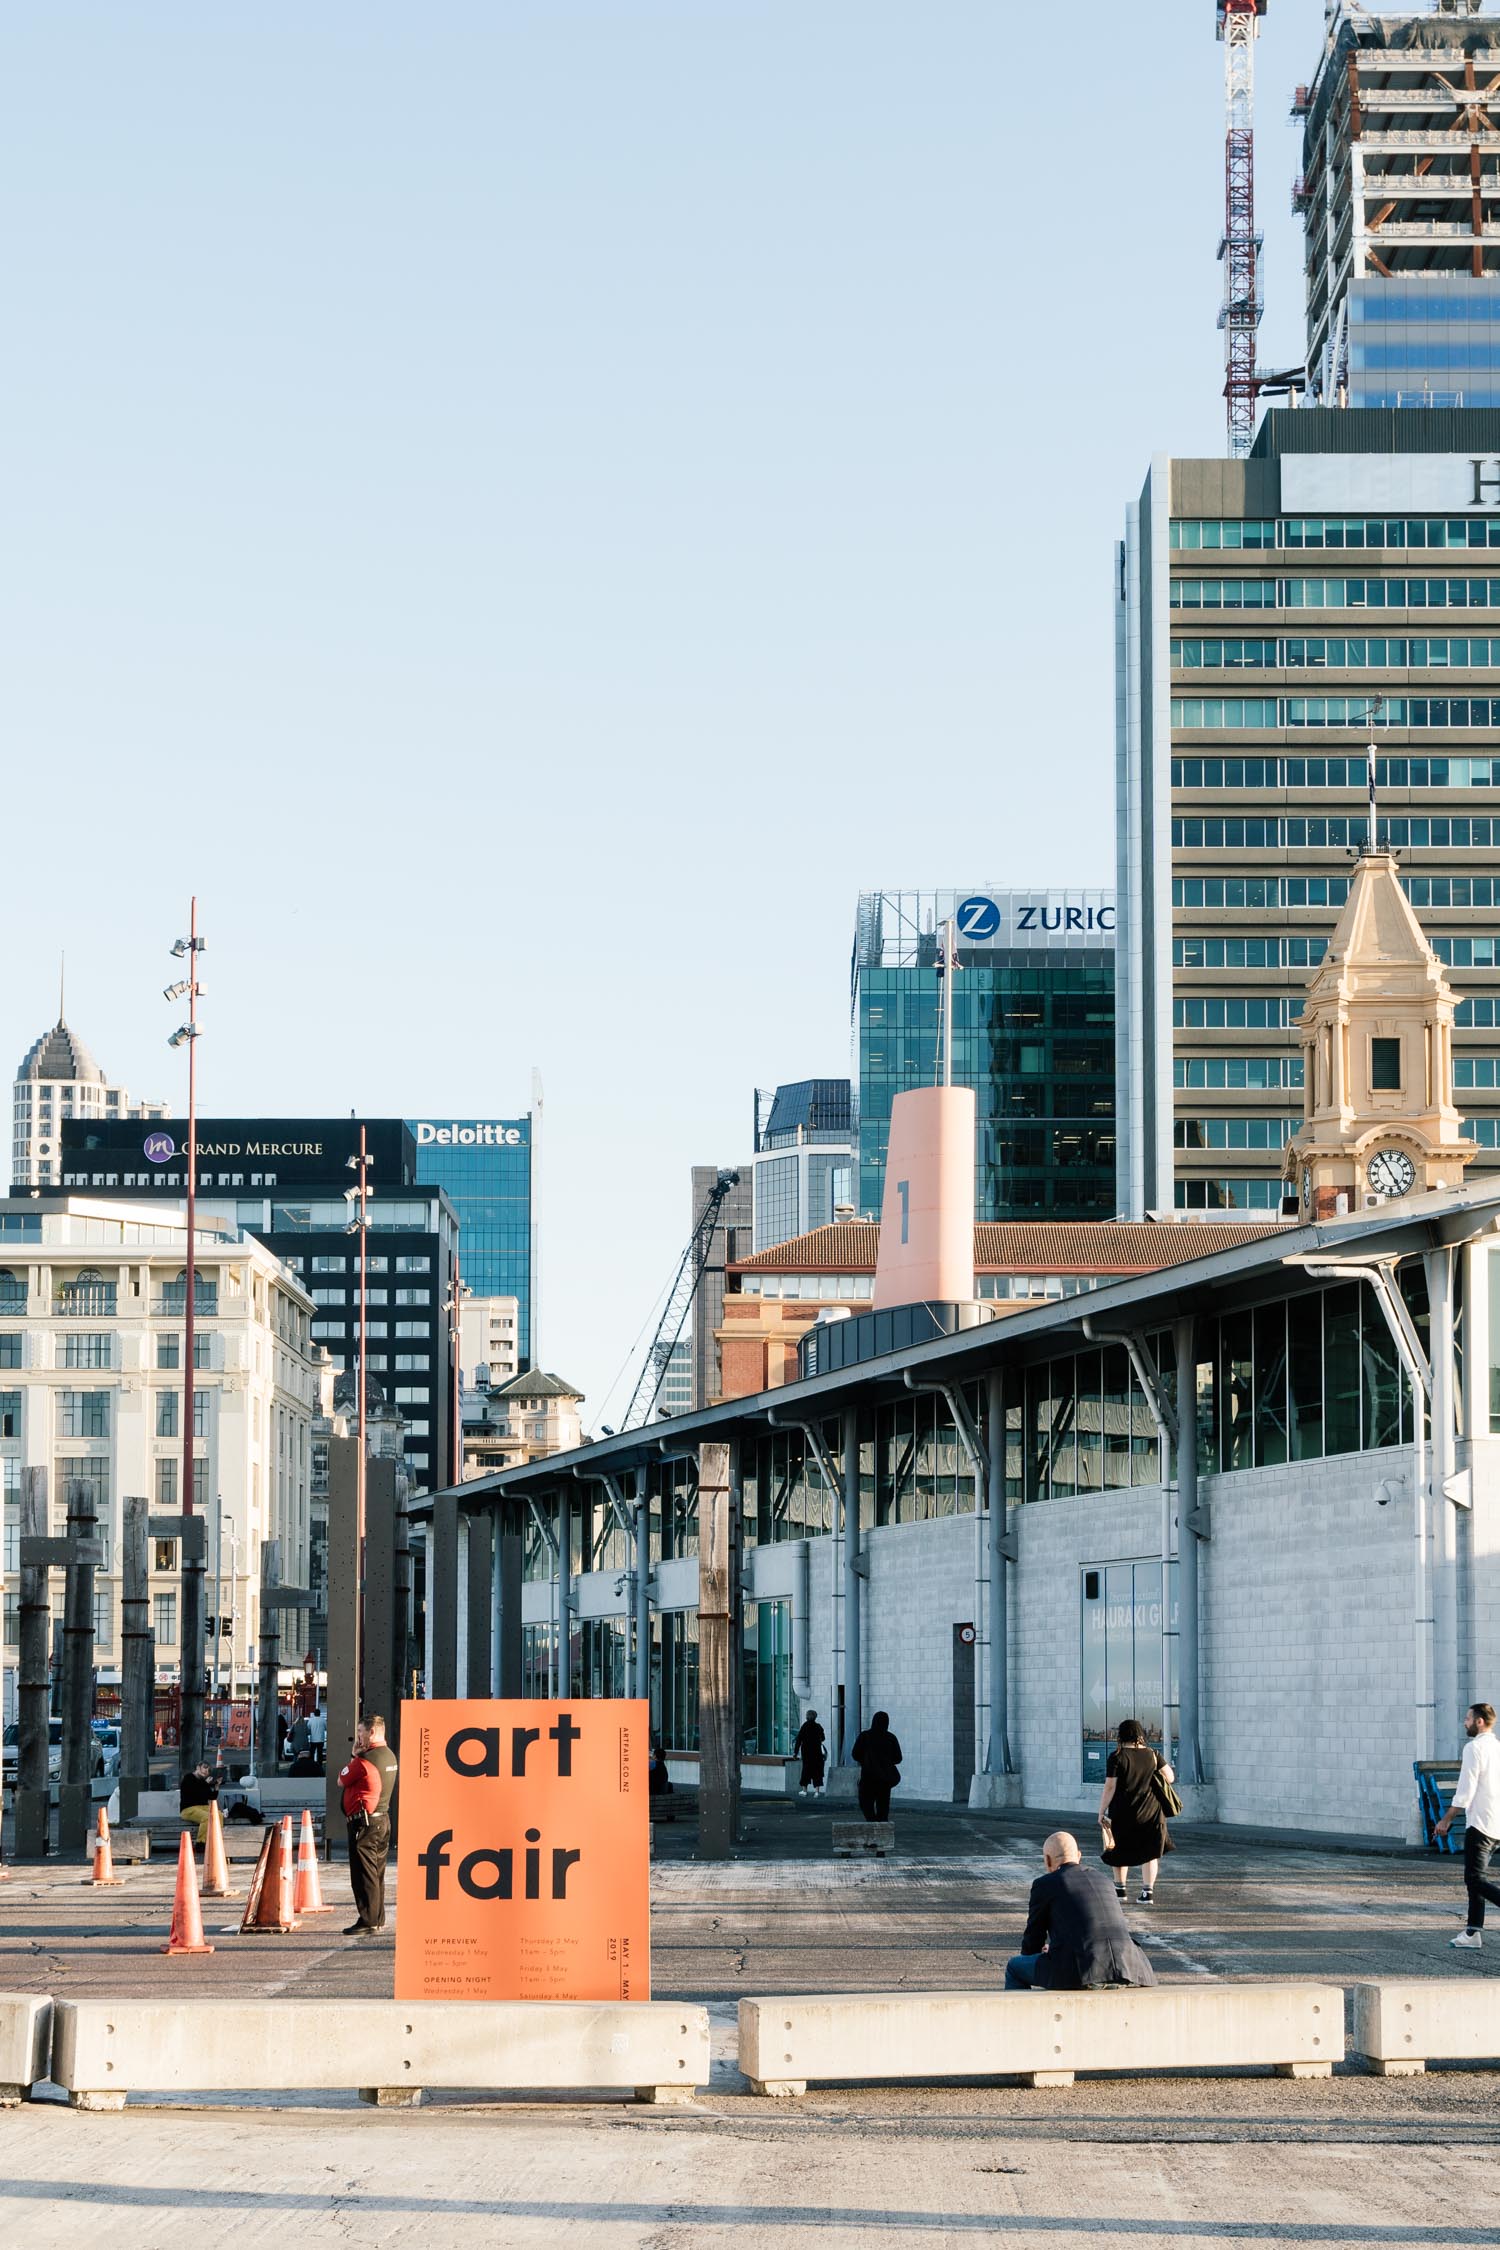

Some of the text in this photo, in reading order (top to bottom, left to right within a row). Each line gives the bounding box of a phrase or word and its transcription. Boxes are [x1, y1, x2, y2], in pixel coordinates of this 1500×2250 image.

[245, 1142, 323, 1155] MERCURE
[897, 1180, 909, 1244] 1
[965, 1631, 971, 1639] 5
[445, 1714, 581, 1777] art
[418, 1828, 580, 1900] fair
[609, 1938, 617, 1961] 2019
[622, 1938, 630, 1959] MAY
[520, 1992, 553, 2000] Saturday
[622, 1979, 630, 2000] MAY
